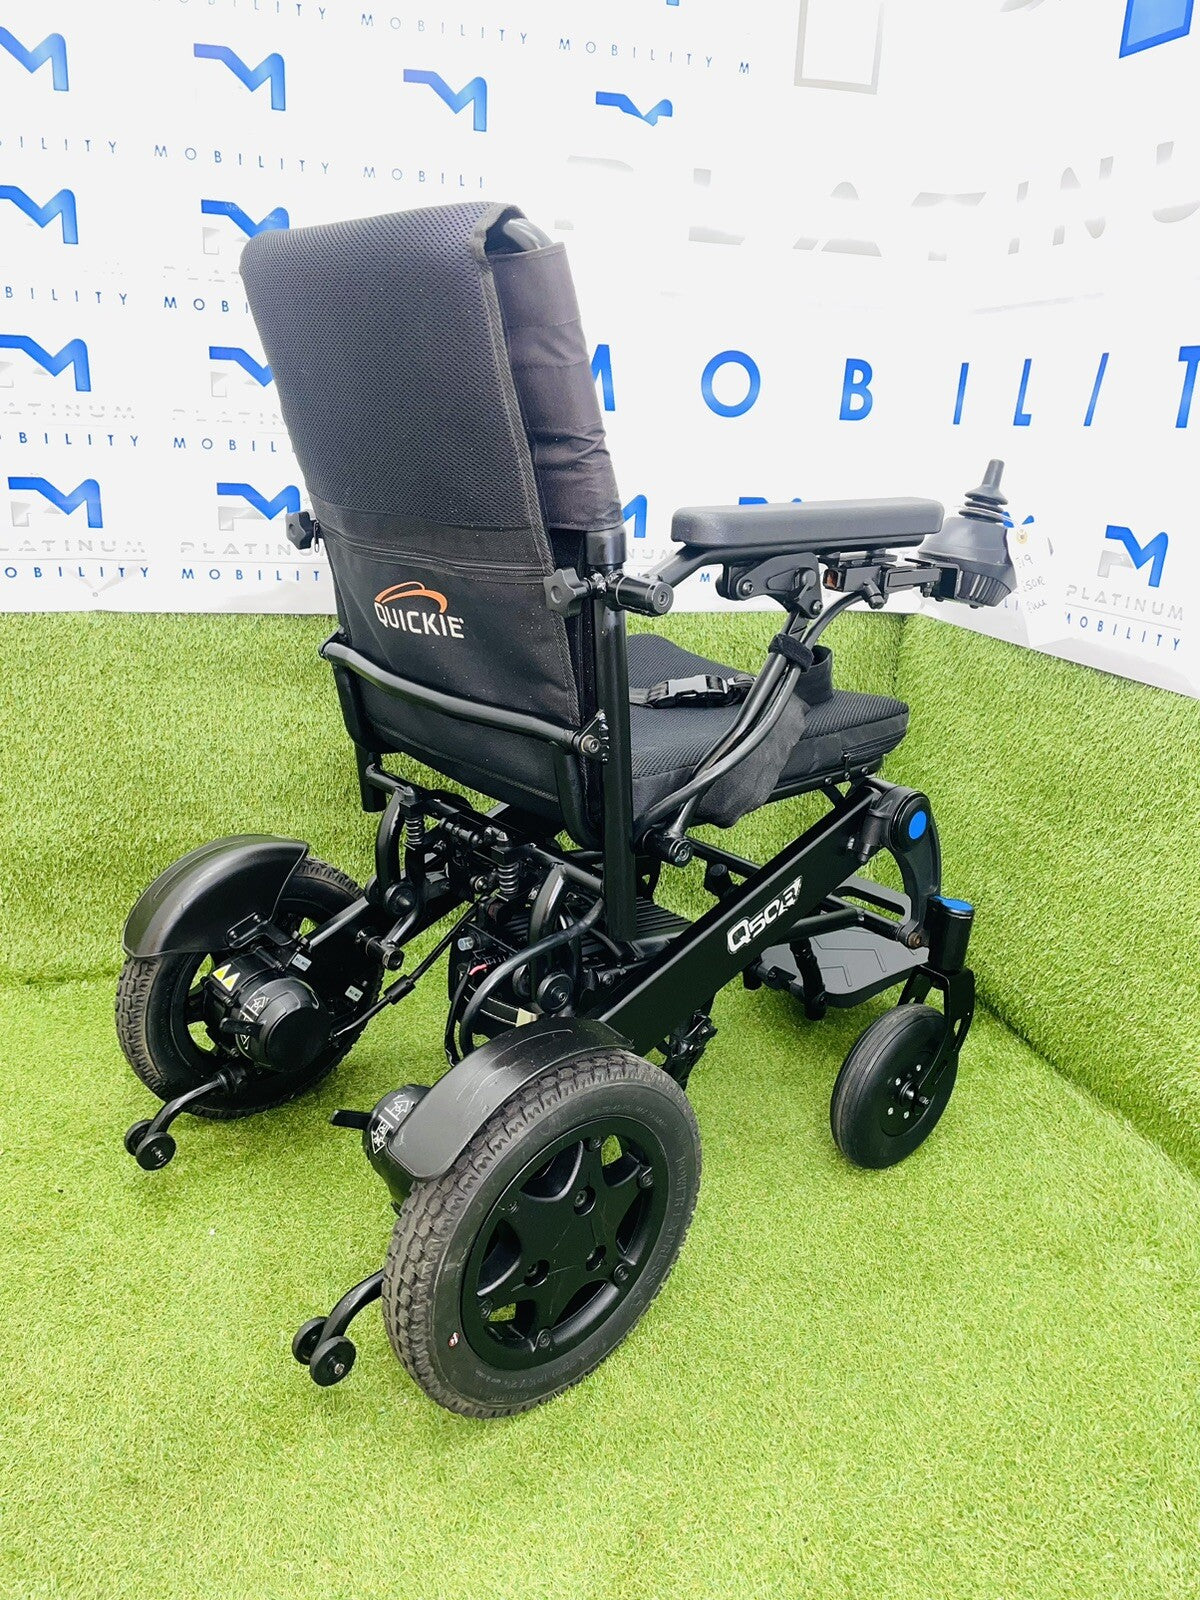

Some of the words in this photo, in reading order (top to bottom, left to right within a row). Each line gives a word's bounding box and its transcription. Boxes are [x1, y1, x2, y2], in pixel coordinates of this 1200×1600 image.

[177, 0, 325, 20] ILITY
[361, 13, 527, 44] MOBILITY
[558, 38, 712, 68] MOBILITY
[0, 136, 116, 153] ILITY
[154, 145, 329, 174] MOBILITY
[0, 432, 138, 447] BILITY
[374, 601, 464, 639] QUICKIE
